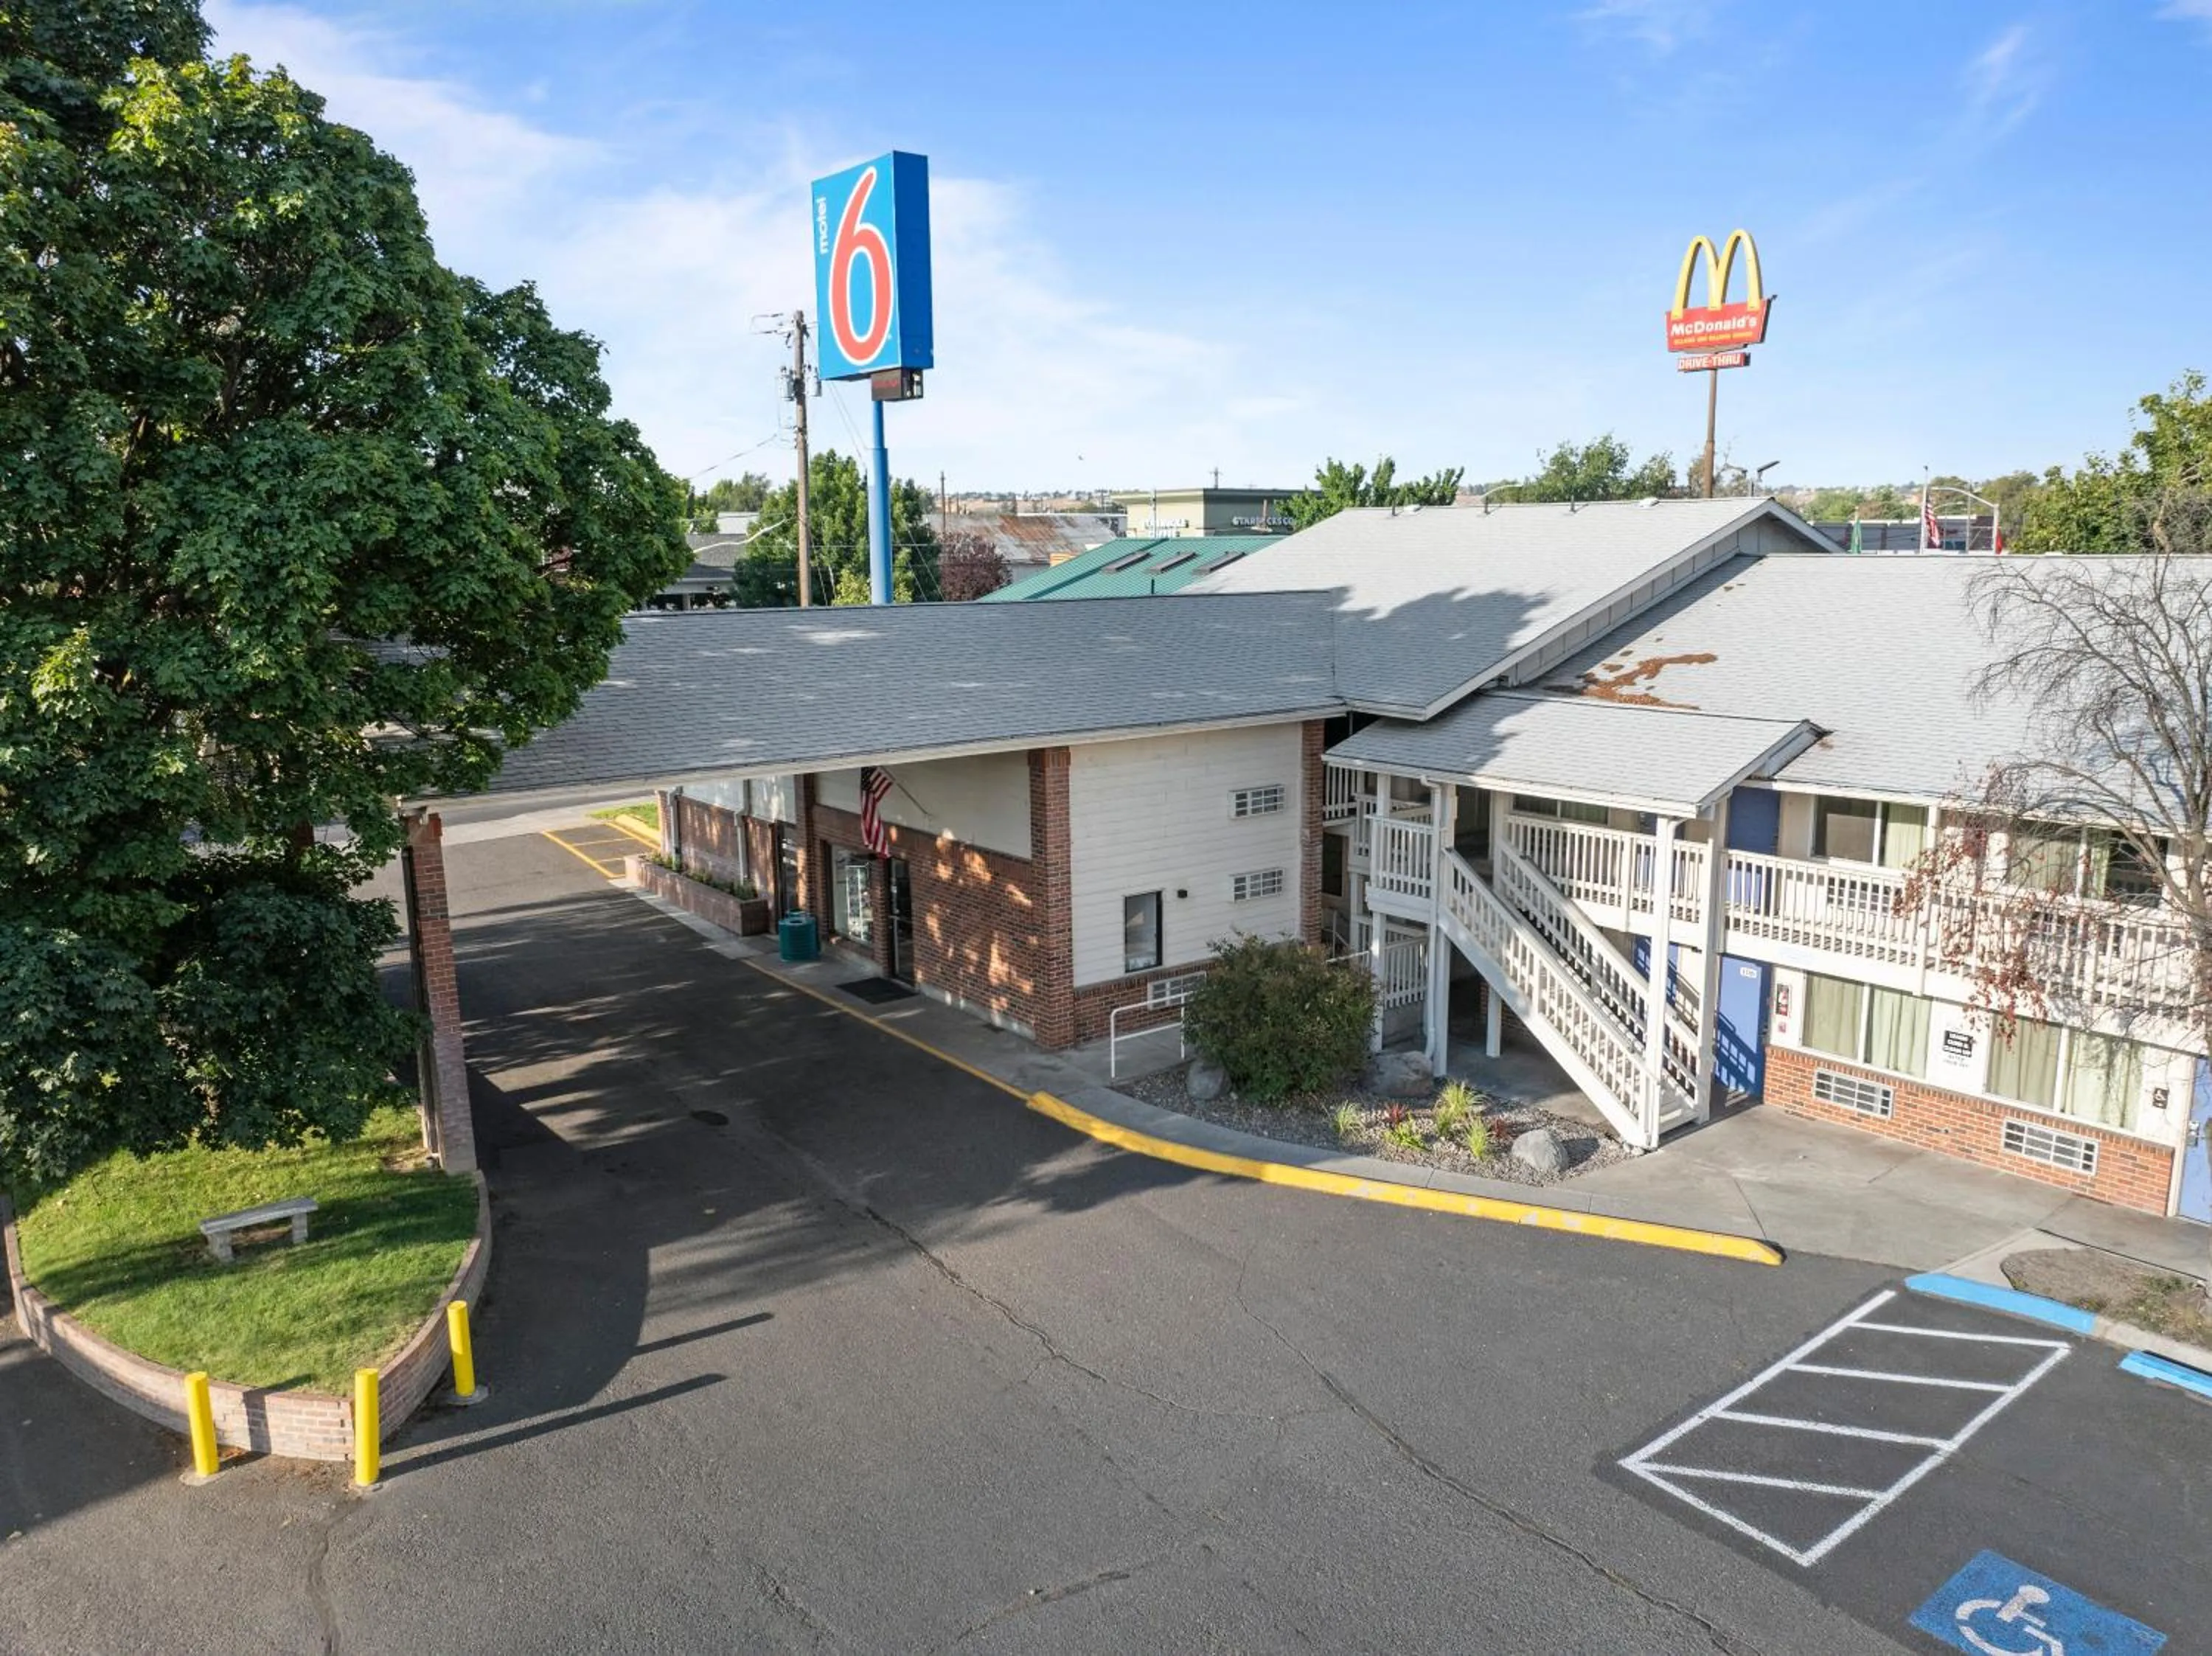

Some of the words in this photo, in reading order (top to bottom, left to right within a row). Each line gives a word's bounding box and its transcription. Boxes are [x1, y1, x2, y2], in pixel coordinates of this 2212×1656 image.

[816, 197, 829, 254] motel
[829, 167, 894, 365] 6
[1671, 316, 1757, 335] McDonald's
